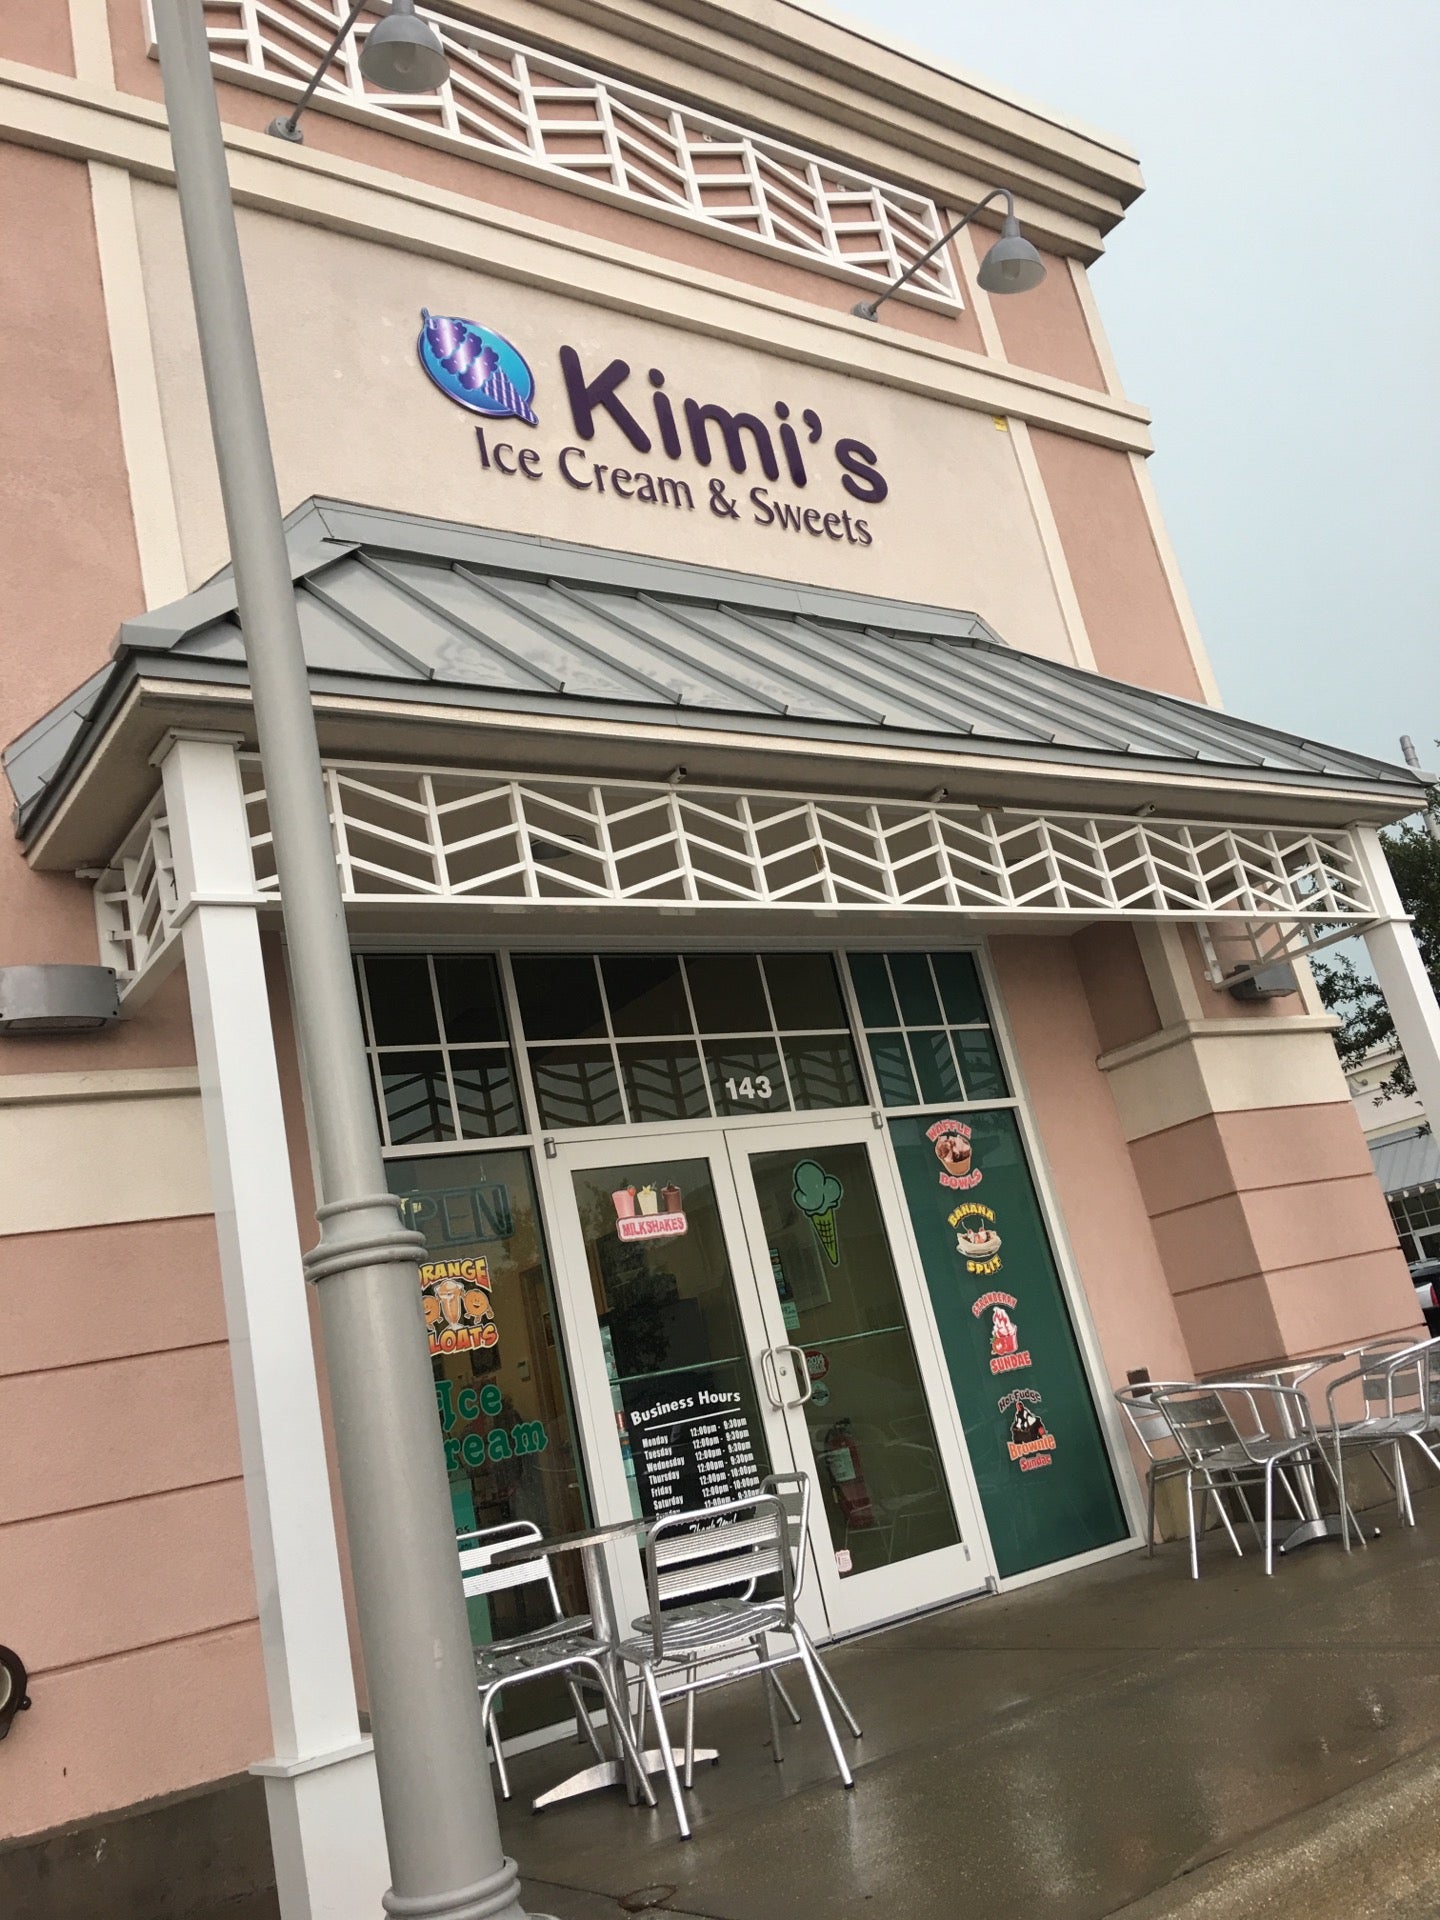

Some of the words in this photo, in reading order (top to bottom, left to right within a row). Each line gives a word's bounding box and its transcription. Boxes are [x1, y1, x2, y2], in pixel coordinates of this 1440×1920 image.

[559, 345, 888, 503] Kimi's
[475, 426, 543, 477] Ice
[558, 447, 696, 509] Cream
[709, 477, 741, 519] &
[750, 486, 874, 546] Sweets
[725, 1075, 773, 1100] 143
[926, 1119, 972, 1142] WAFFLE
[939, 1168, 983, 1190] BOWLS
[400, 1185, 511, 1243] PEN
[622, 1217, 685, 1237] MILKSHAKES
[948, 1203, 996, 1229] BANANA
[418, 1256, 491, 1291] RANGE
[966, 1254, 1002, 1275] SPLIT
[428, 1323, 498, 1355] LOATS
[990, 1350, 1032, 1375] SUNDAE
[436, 1380, 502, 1432] Ice
[630, 1397, 694, 1426] Business
[698, 1390, 741, 1405] Hours
[444, 1420, 548, 1471] ream
[642, 1435, 668, 1448] Monday
[690, 1424, 717, 1437] 12:00pm
[644, 1447, 672, 1460] Tuesday
[692, 1436, 719, 1449] 12:00pm
[1007, 1433, 1056, 1461] Brownie
[646, 1456, 685, 1472] Wednesday
[695, 1448, 722, 1461] 12:00pm
[649, 1470, 680, 1485] Thursday
[697, 1460, 724, 1473] 12:00pm
[1020, 1454, 1052, 1473] Sundae
[651, 1485, 672, 1498] Friday
[699, 1472, 727, 1486] 12:00pm
[653, 1495, 684, 1510] Saturday
[702, 1484, 729, 1498] 12:00pm
